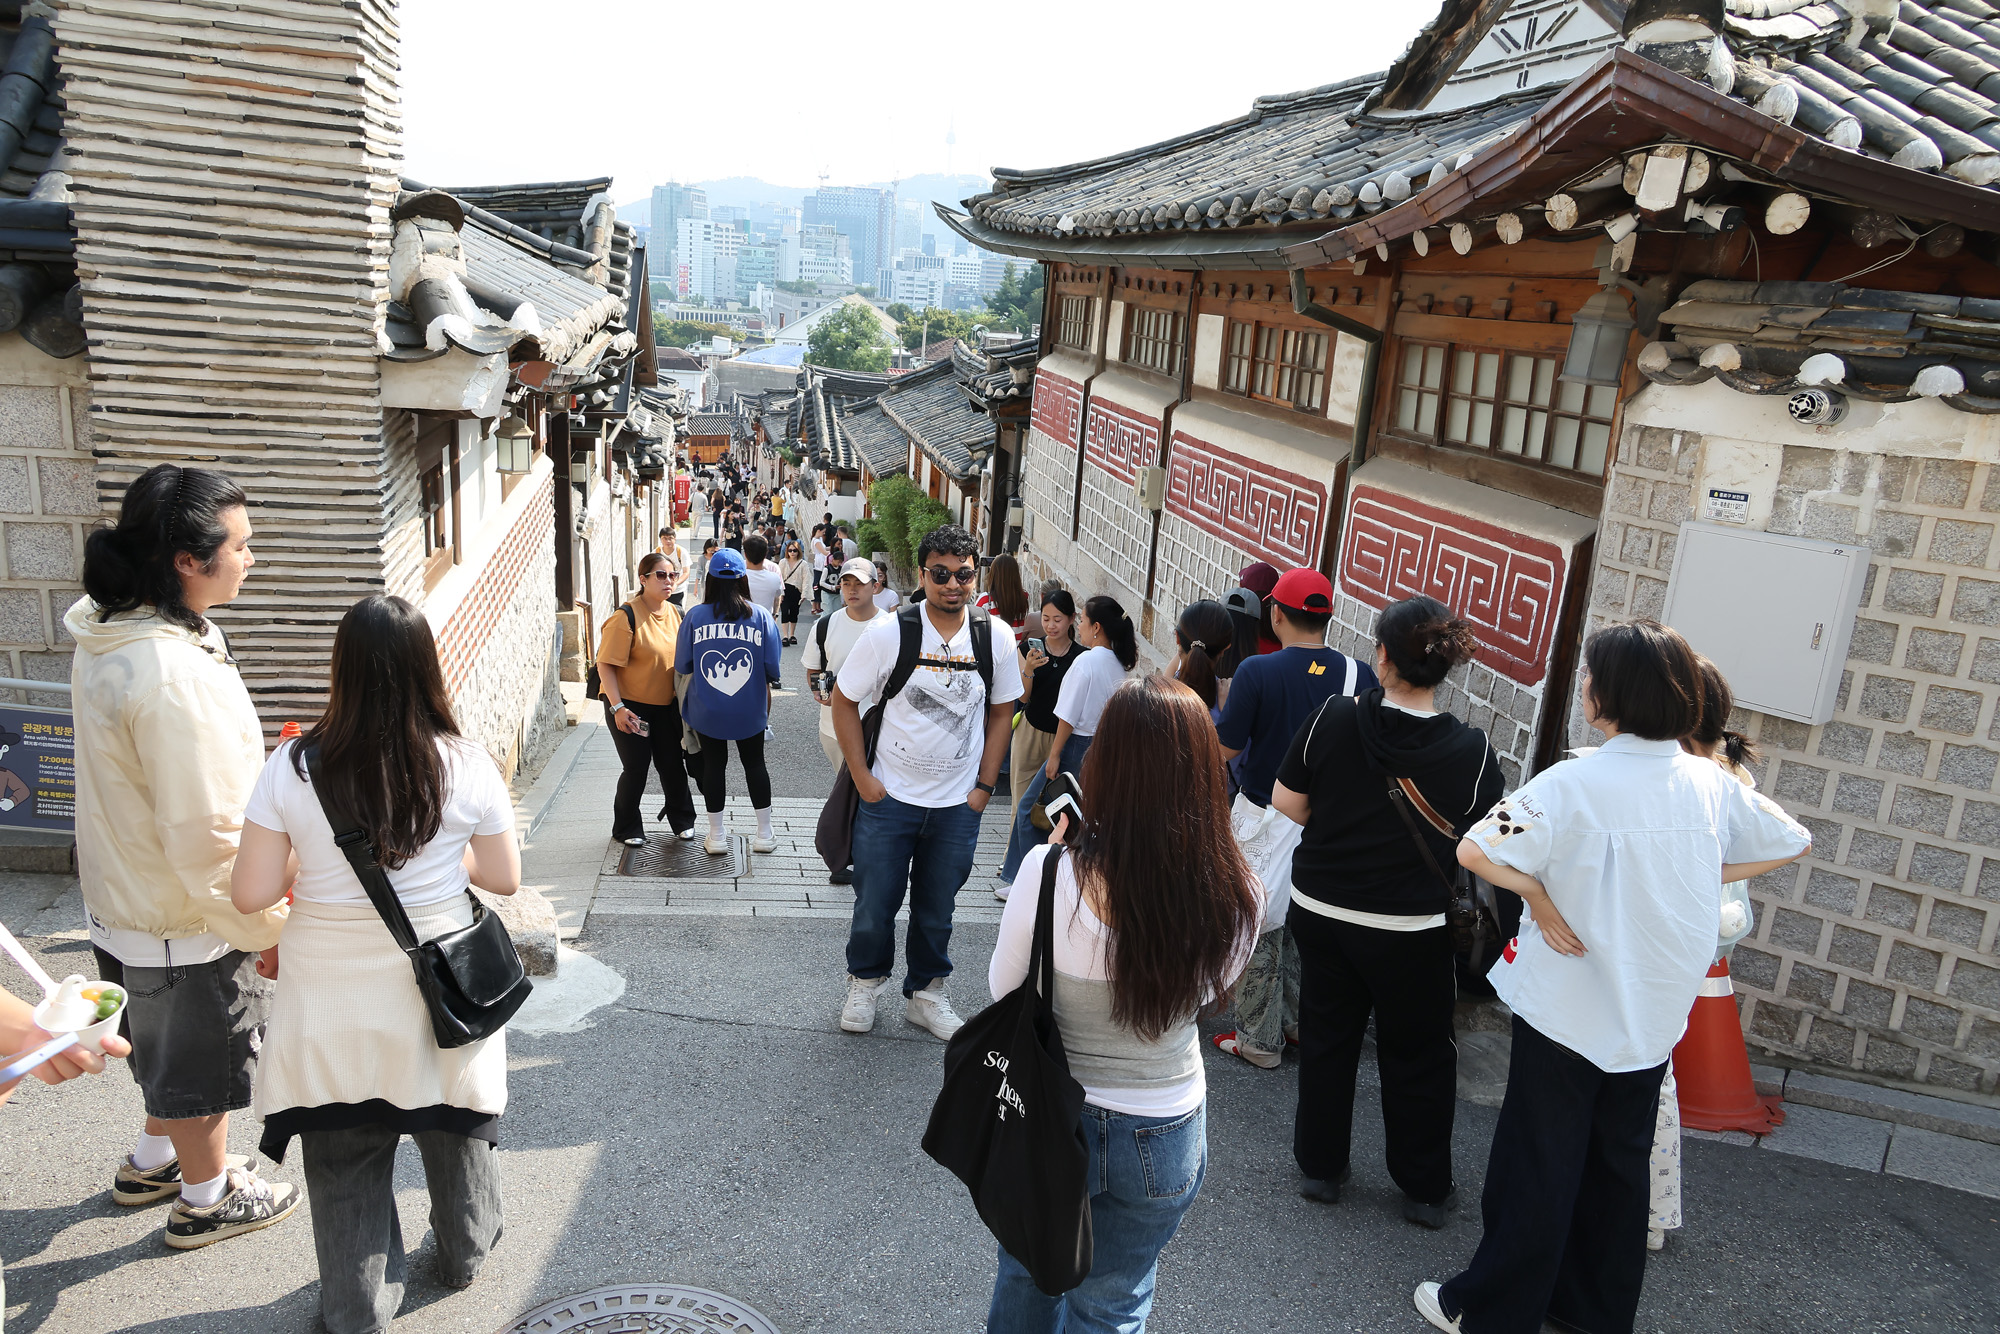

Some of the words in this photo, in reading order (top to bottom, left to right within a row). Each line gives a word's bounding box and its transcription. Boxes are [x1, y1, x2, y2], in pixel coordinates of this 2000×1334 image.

[694, 623, 762, 646] EINKLANG
[22, 723, 52, 734] 관광객
[54, 726, 74, 737] 방문
